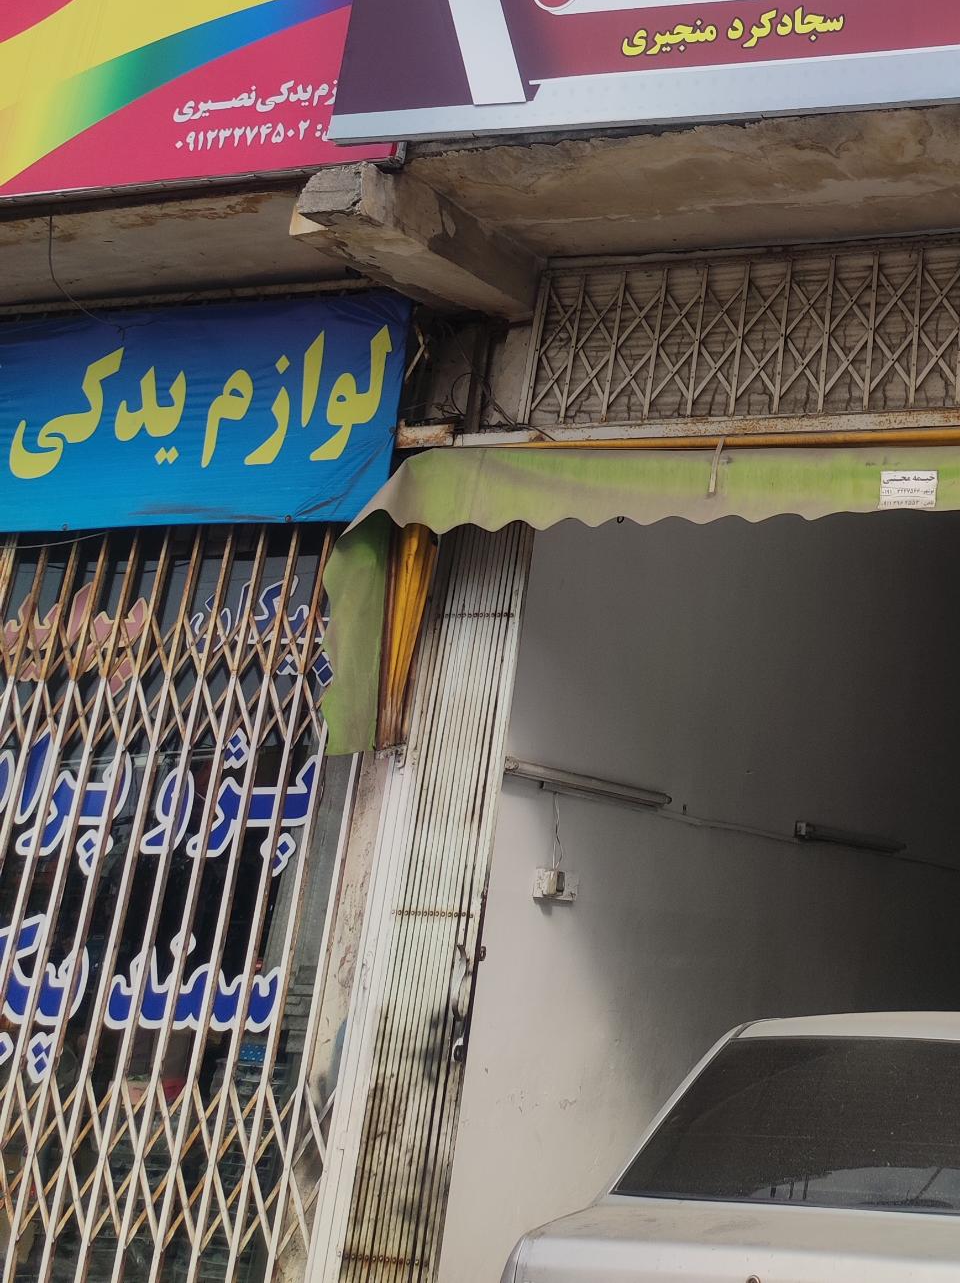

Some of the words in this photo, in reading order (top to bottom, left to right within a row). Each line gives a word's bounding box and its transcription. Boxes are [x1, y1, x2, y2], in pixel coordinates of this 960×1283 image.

[621, 19, 719, 57] منجیری
[172, 85, 257, 123] نصیری
[255, 80, 313, 113] یدکی
[8, 346, 188, 480] یدکی
[200, 323, 394, 469] لوازم
